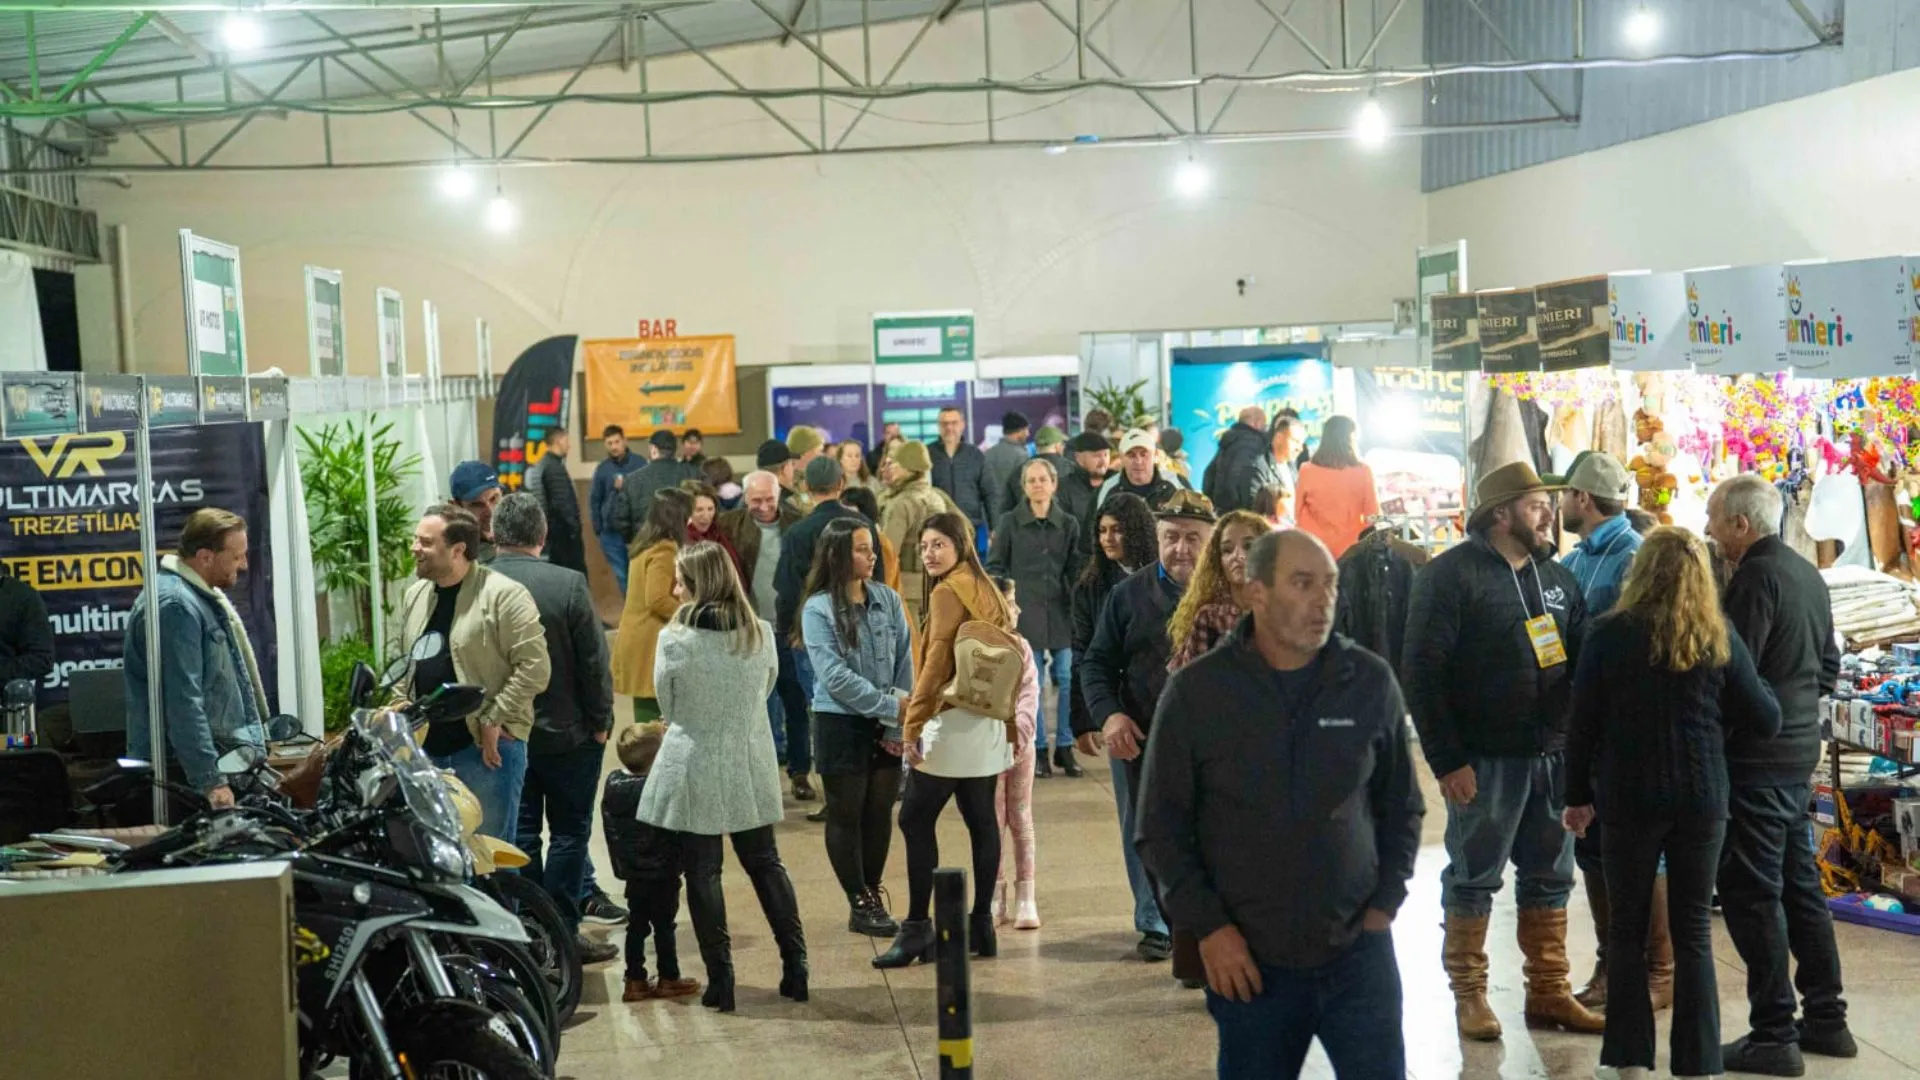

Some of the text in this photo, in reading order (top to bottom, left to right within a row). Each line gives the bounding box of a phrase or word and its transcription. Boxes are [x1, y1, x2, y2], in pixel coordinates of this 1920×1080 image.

[639, 319, 677, 338] BAR
[20, 431, 127, 479] VR
[0, 479, 204, 510] LTIMARAS
[9, 516, 79, 536] TREZE
[37, 558, 83, 586] EM
[89, 555, 144, 583] CON
